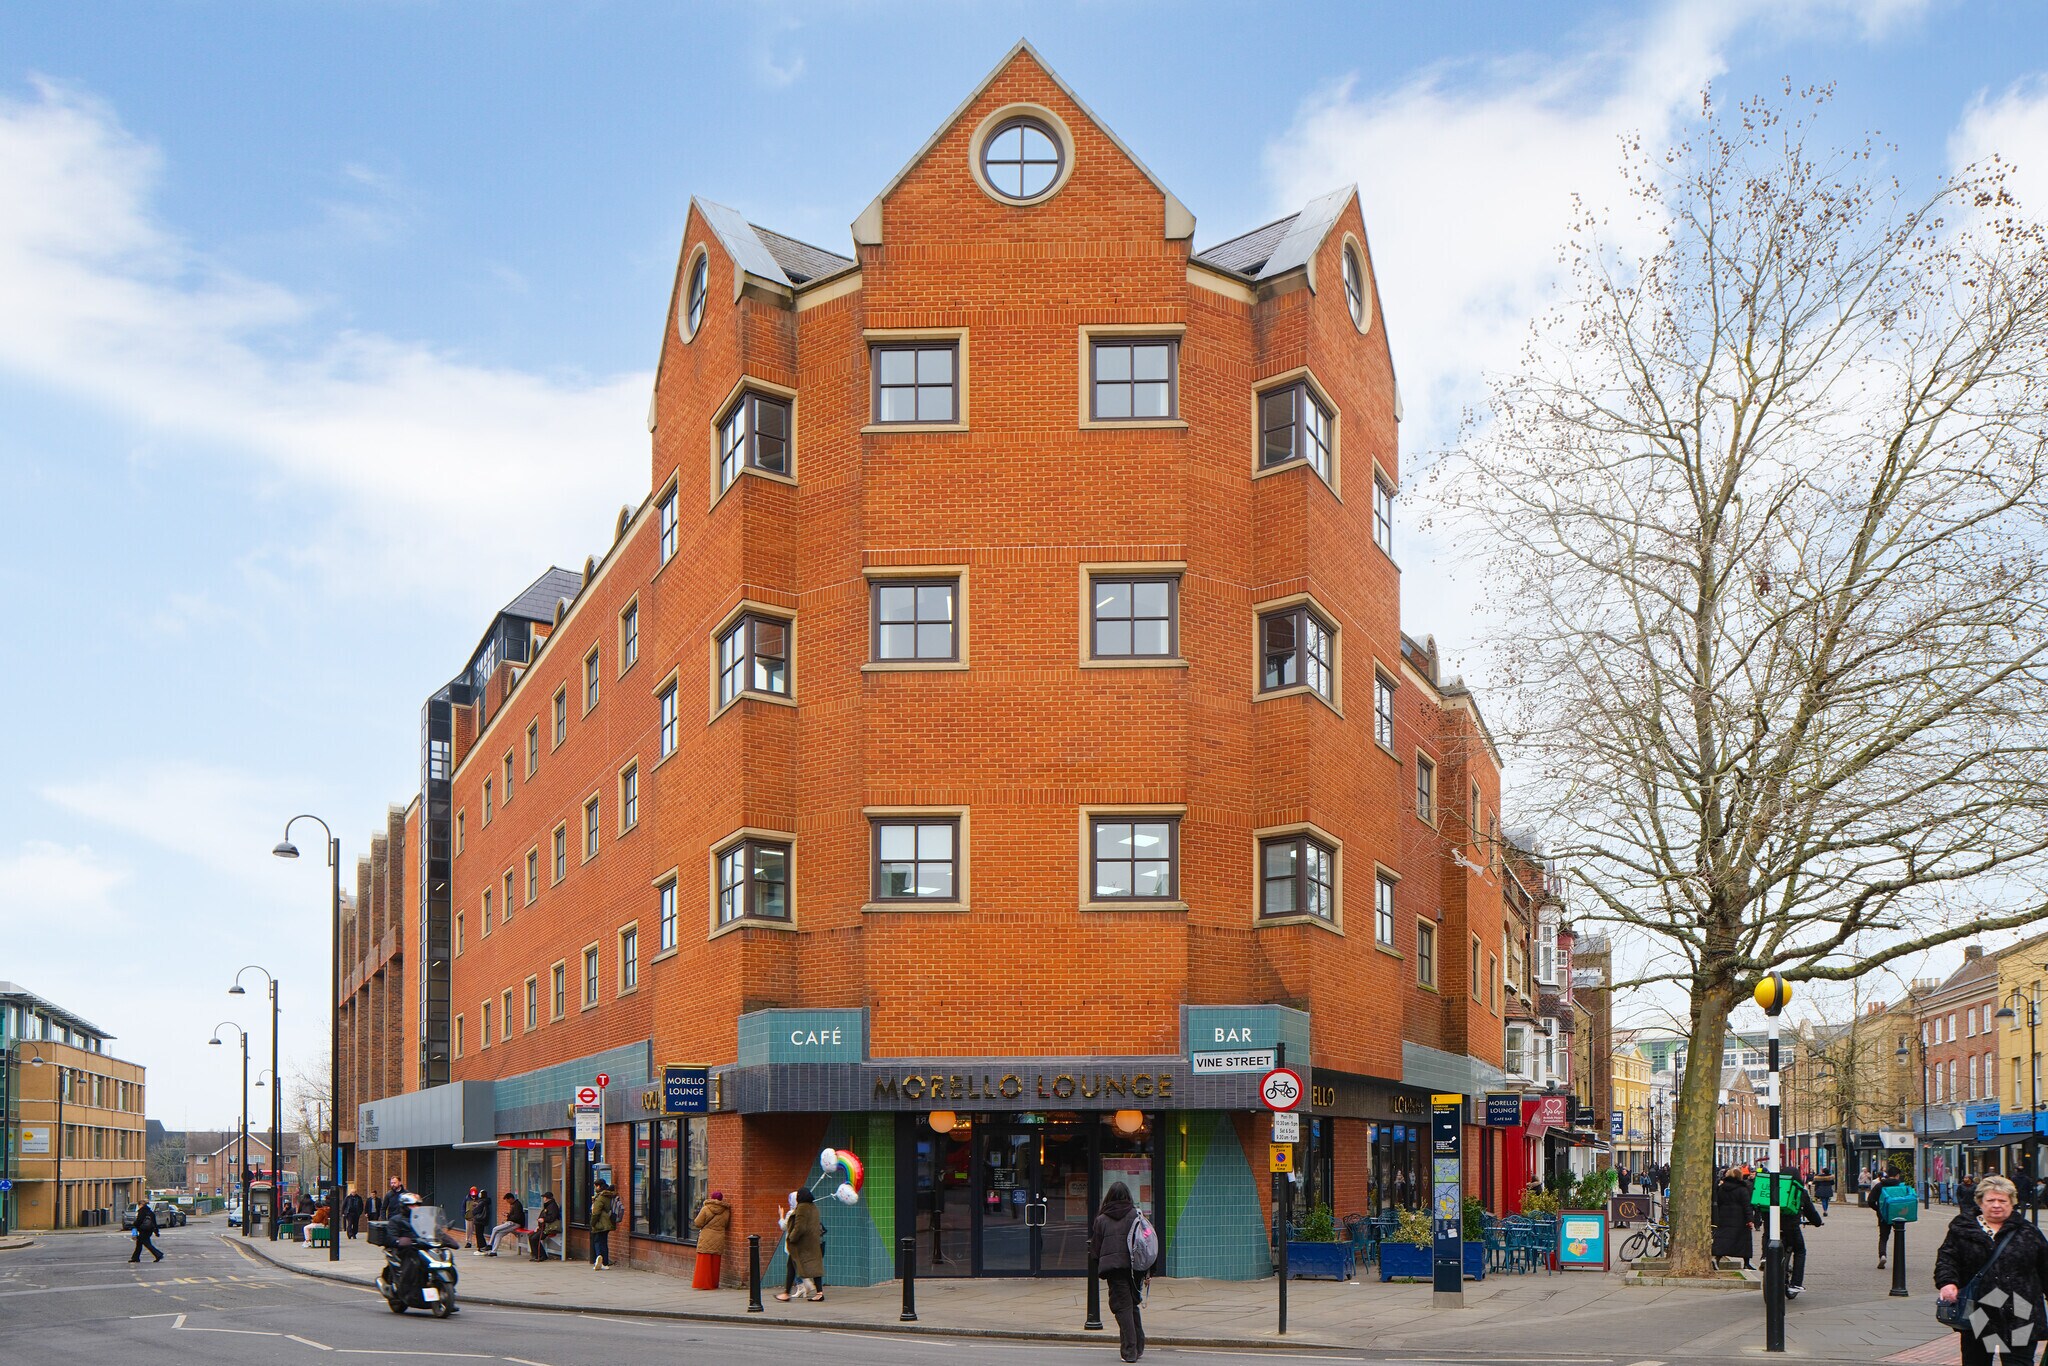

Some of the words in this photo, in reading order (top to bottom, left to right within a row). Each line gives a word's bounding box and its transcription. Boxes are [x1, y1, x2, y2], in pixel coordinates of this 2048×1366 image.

[791, 1027, 842, 1045] CAFÉ
[1214, 1028, 1252, 1042] BAR
[1196, 1057, 1223, 1067] VINE
[1226, 1056, 1271, 1066] STREET
[599, 1075, 606, 1085] T
[667, 1077, 705, 1085] MORELLO
[669, 1087, 704, 1096] LOUNGE
[874, 1074, 1022, 1099] MORELLO
[1038, 1073, 1172, 1099] LOUNGE
